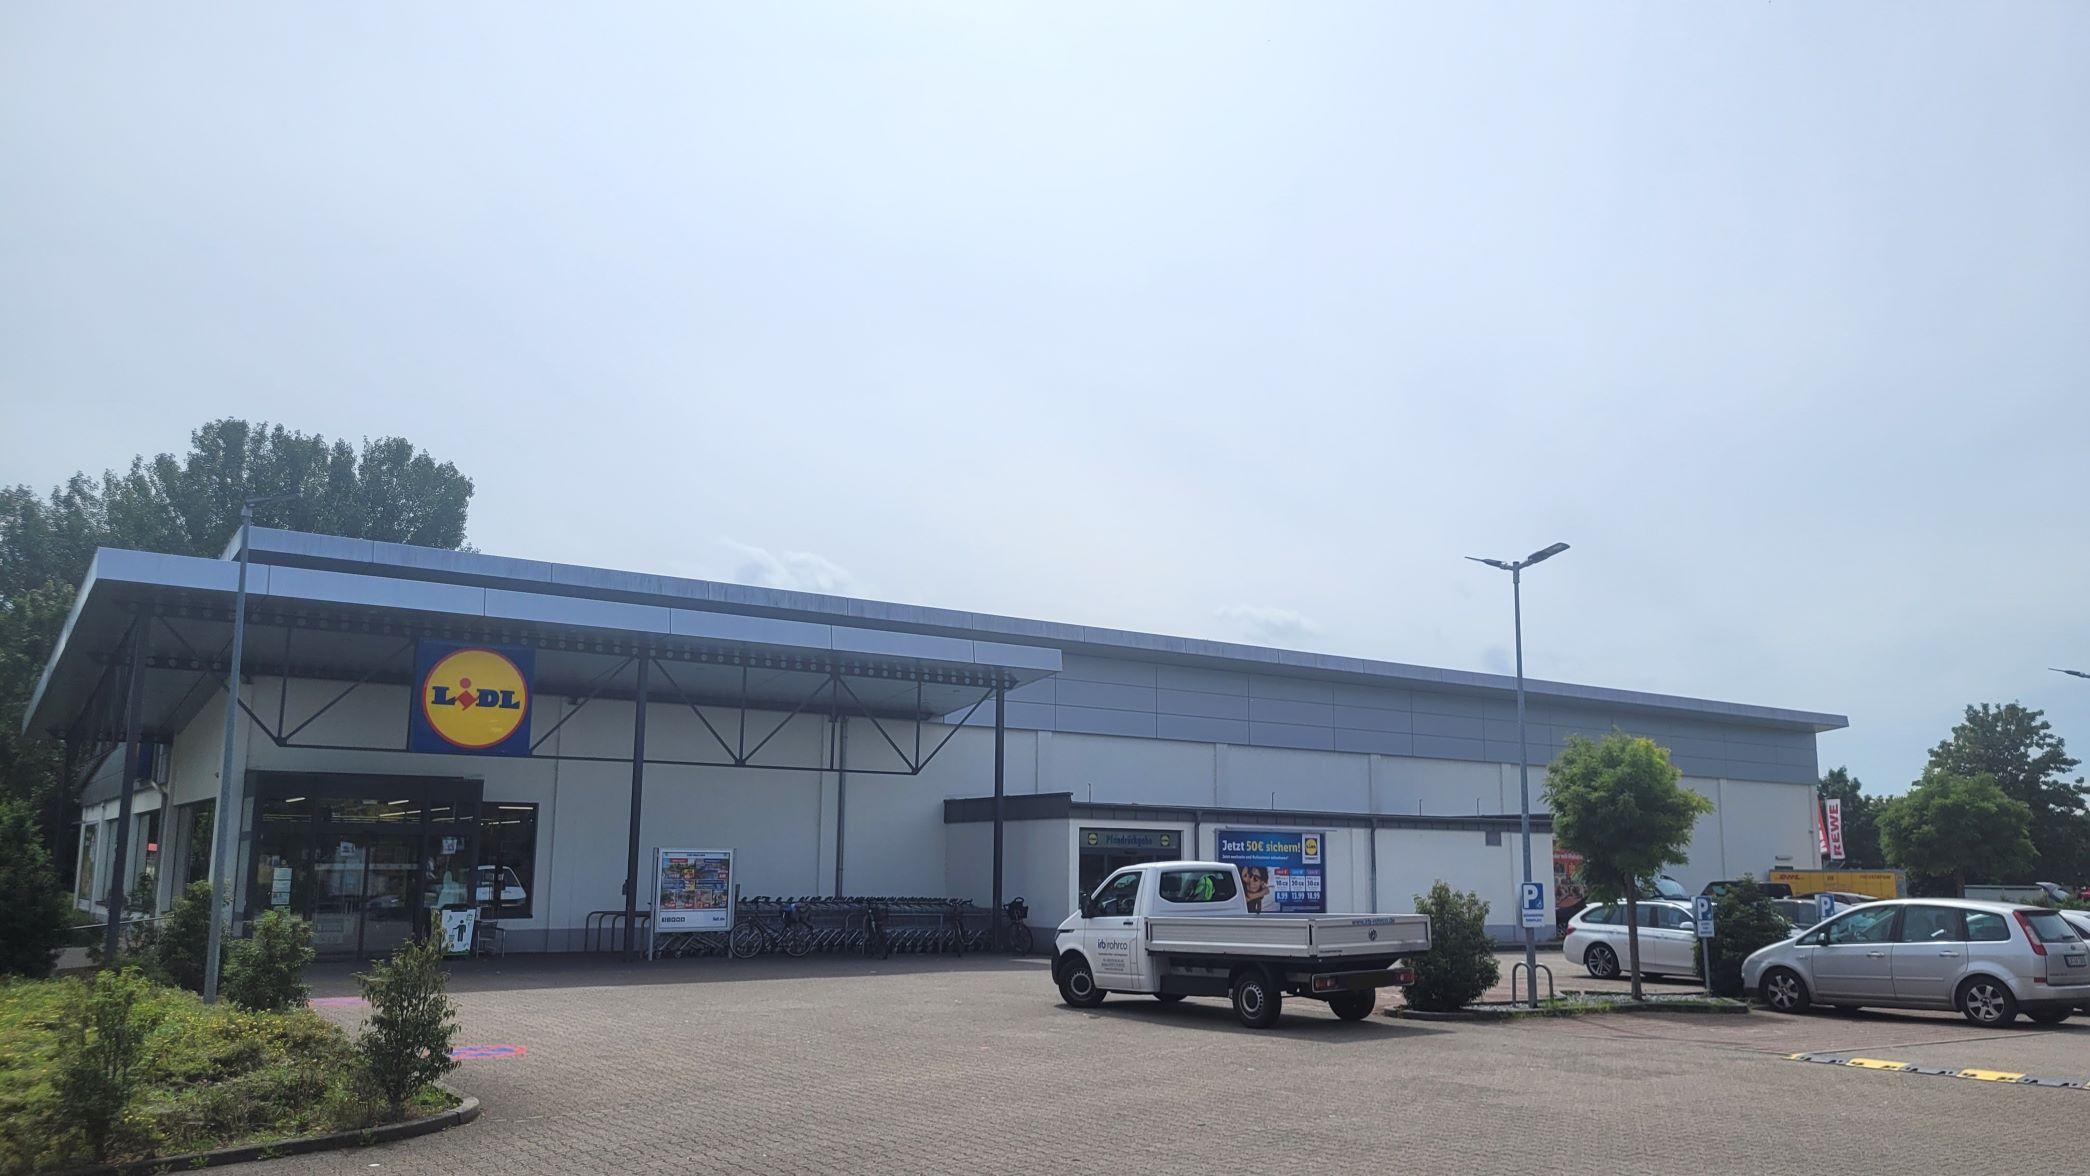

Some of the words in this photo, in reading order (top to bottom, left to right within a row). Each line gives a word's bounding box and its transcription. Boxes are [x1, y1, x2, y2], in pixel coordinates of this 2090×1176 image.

[1829, 803, 1843, 855] REWE
[1222, 840, 1245, 851] Jetzt
[1246, 841, 1264, 852] 50€
[1265, 841, 1301, 853] sichern!
[1523, 884, 1539, 909] P
[1821, 896, 1832, 916] P
[1697, 898, 1709, 920] P
[1097, 938, 1106, 949] irb
[1106, 939, 1128, 950] rohrco
